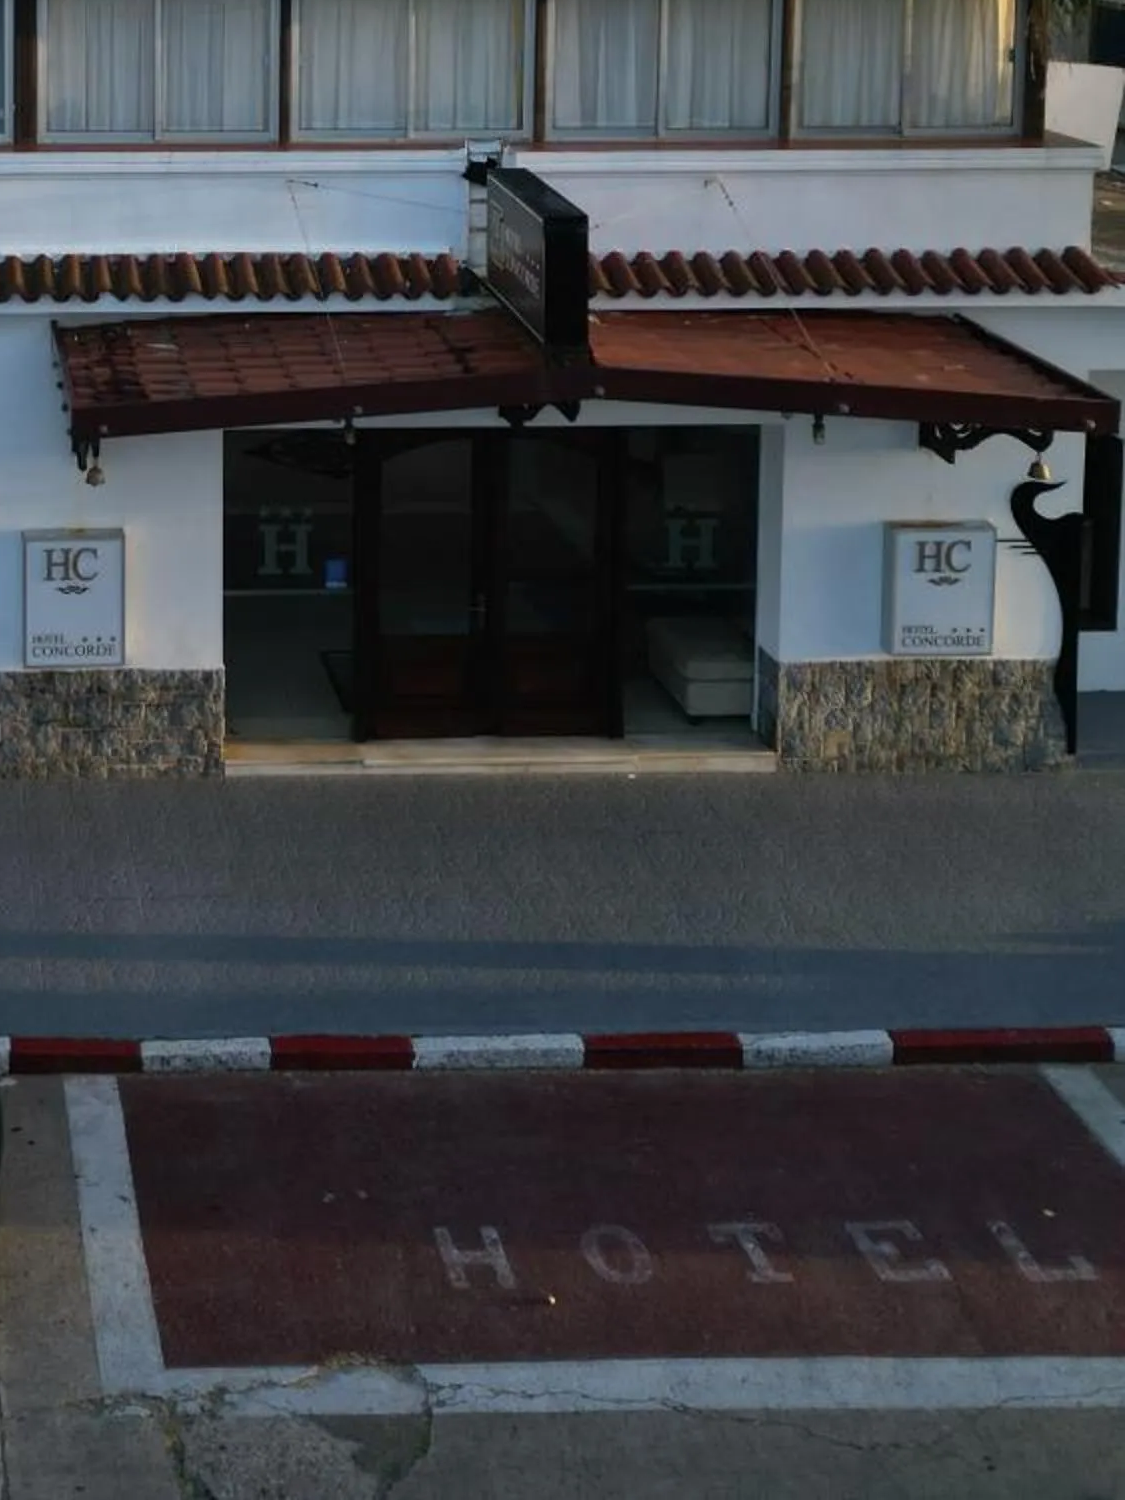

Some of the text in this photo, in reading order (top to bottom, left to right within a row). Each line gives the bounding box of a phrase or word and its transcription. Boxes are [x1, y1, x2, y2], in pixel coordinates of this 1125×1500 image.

[257, 523, 314, 575] H
[661, 517, 722, 570] H
[913, 539, 973, 574] HC
[42, 547, 99, 582] HC
[32, 644, 115, 658] CONCORDE
[902, 635, 984, 647] CONCORDE
[433, 1220, 1100, 1289] HOTEL
